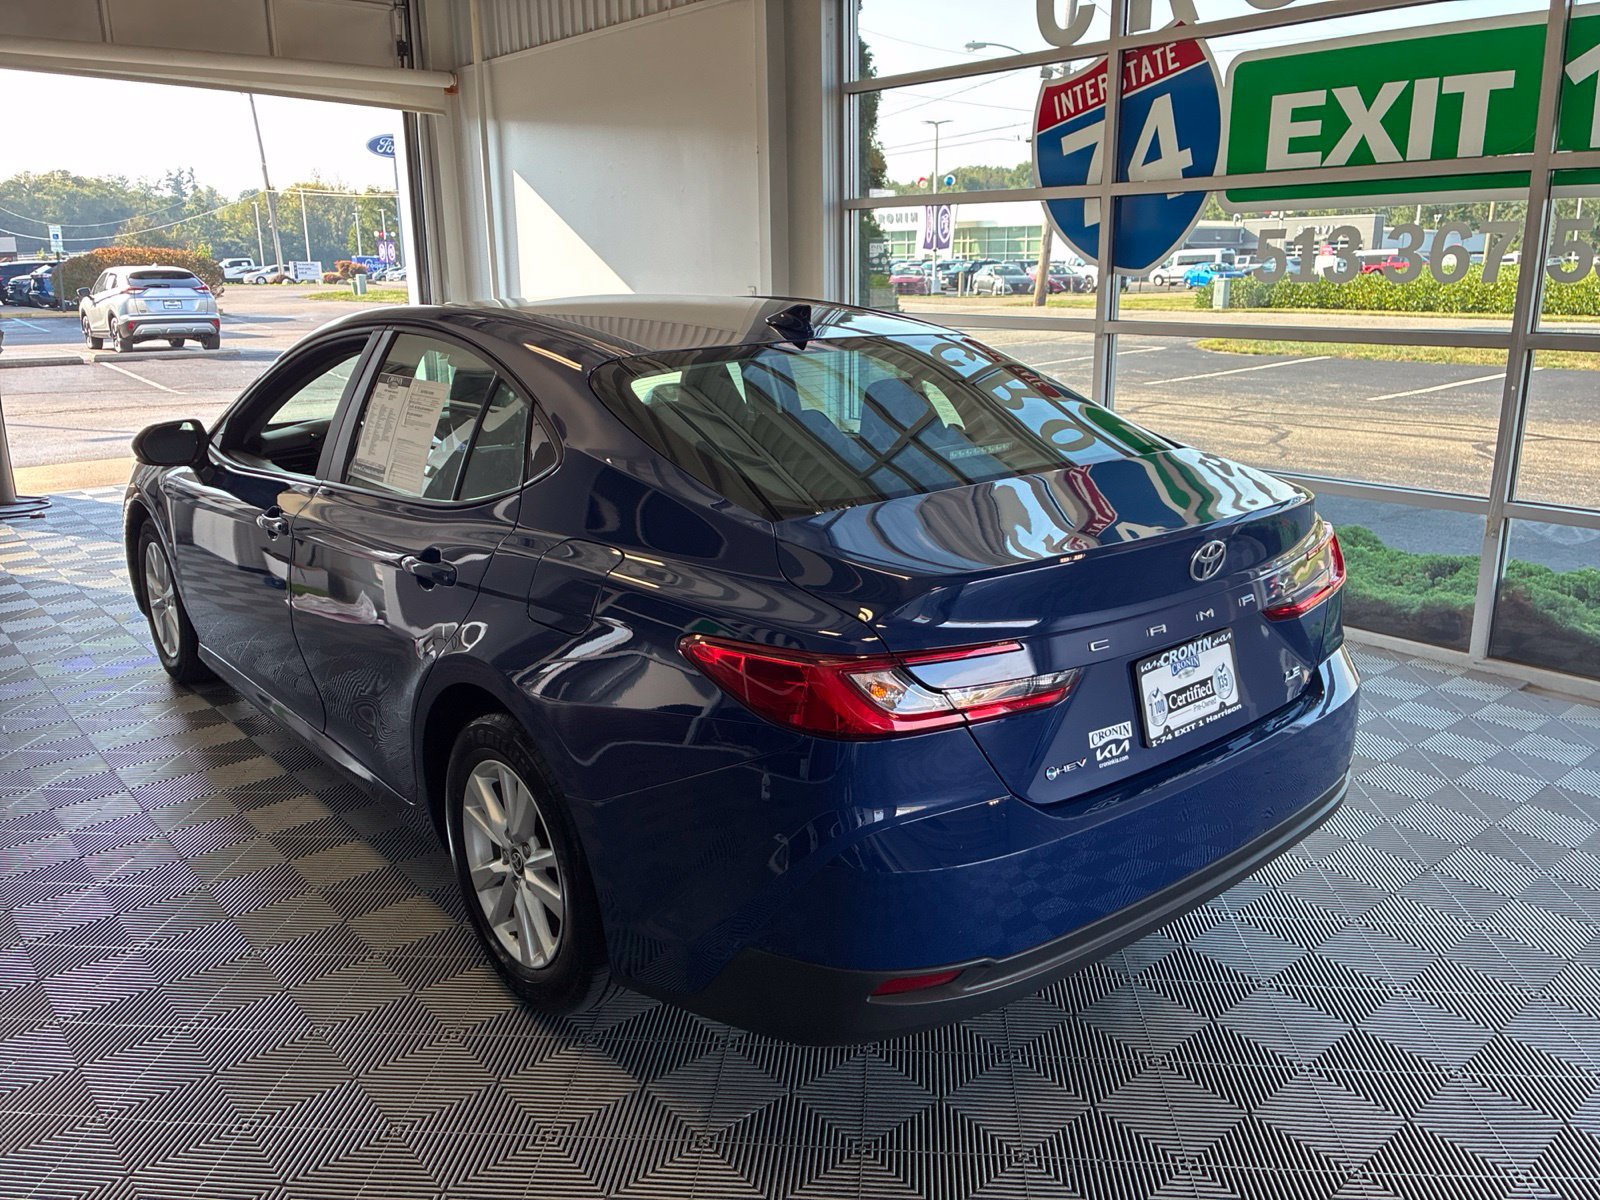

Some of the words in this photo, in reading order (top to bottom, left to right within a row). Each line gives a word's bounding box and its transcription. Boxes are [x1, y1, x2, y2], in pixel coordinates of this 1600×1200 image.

[1054, 42, 1181, 120] INTERTATE
[1266, 70, 1516, 171] EXIT
[377, 137, 394, 153] Fo
[1061, 92, 1194, 228] 74
[1160, 637, 1211, 666] CRONIN
[1172, 656, 1199, 675] CRONIN
[1285, 665, 1300, 683] LE
[1169, 680, 1213, 709] Certified
[1091, 723, 1130, 746] CRONIN
[1152, 733, 1173, 747] I-74
[1174, 724, 1196, 737] EXIT
[1206, 704, 1242, 724] Harrison
[1098, 755, 1129, 769] croninkia.com
